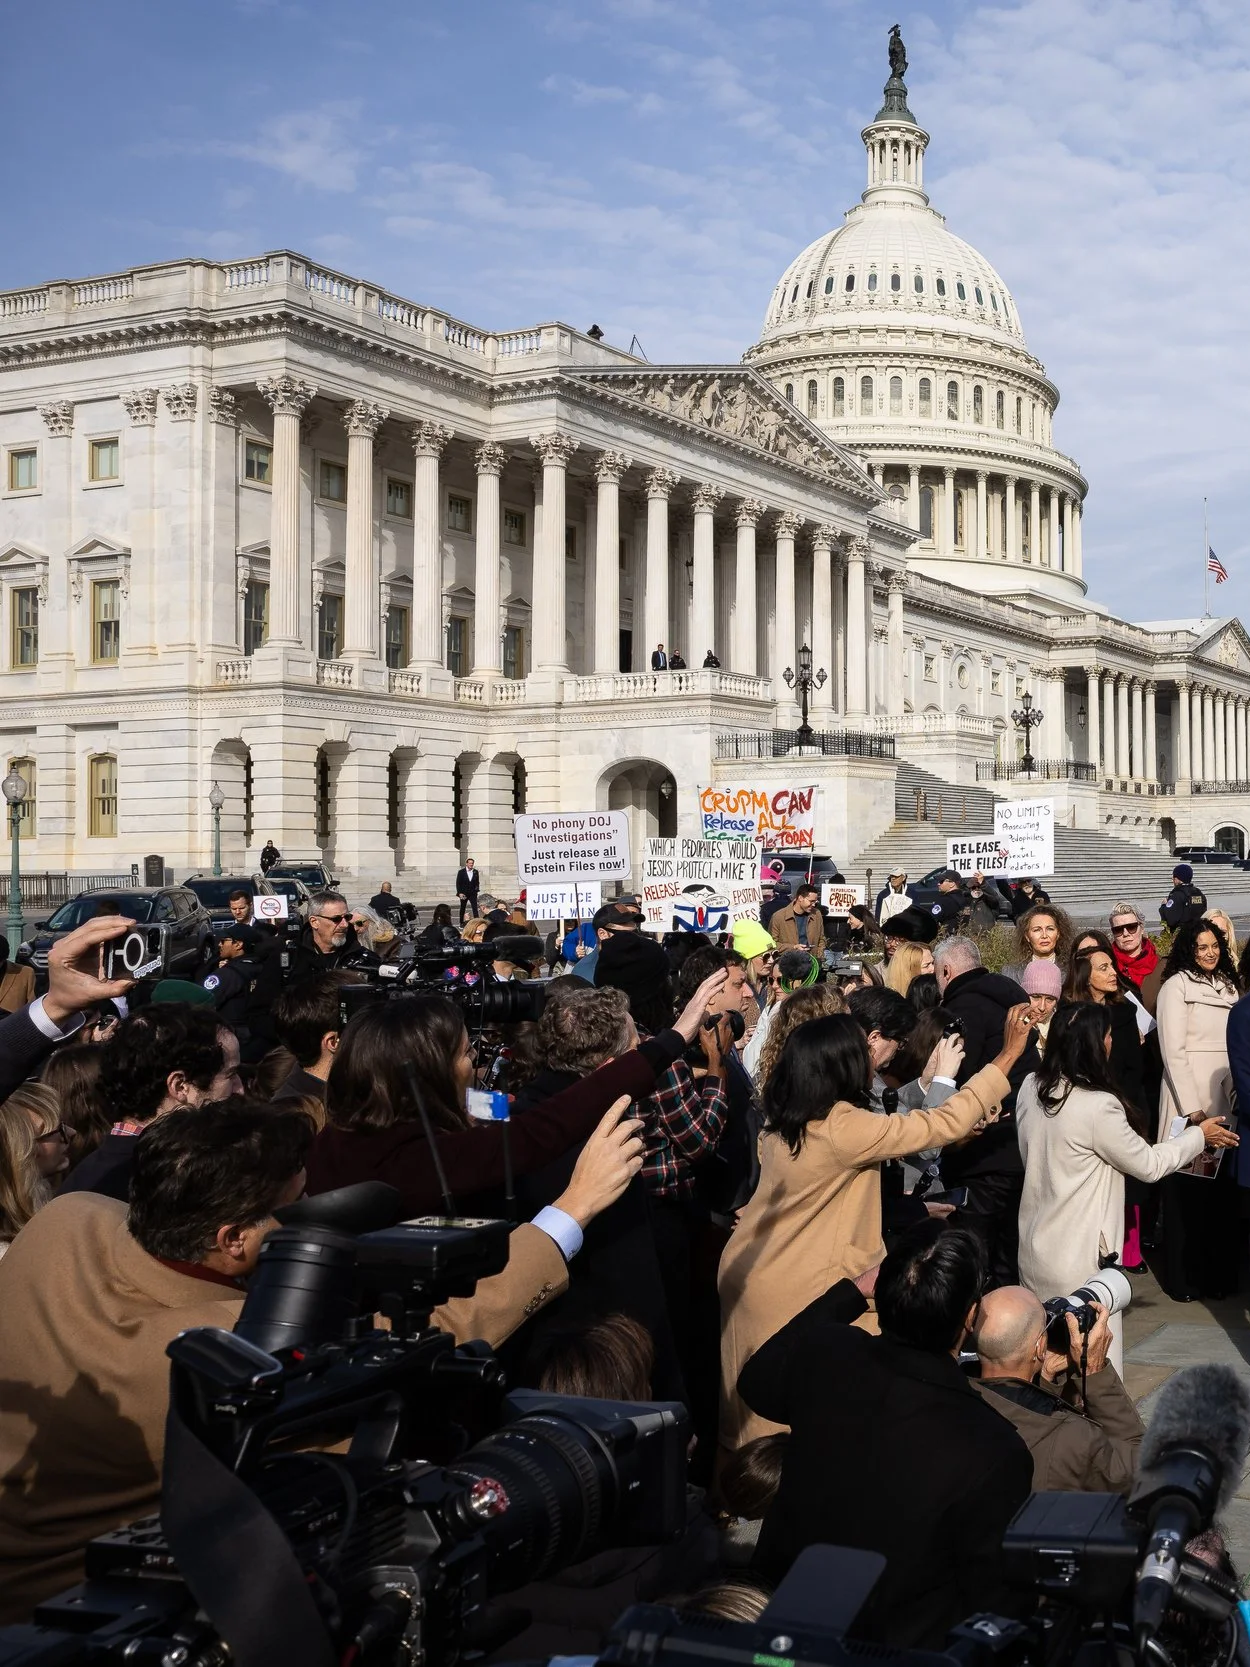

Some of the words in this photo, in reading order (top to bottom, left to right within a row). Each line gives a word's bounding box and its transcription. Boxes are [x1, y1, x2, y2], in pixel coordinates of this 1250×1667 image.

[772, 788, 814, 818] CAN
[997, 808, 1012, 819] NO
[1017, 805, 1051, 818] LIMITS
[532, 819, 548, 830] No
[551, 818, 586, 831] phony
[588, 816, 612, 826] DOJ
[704, 812, 754, 832] Release
[757, 812, 796, 834] ALL
[1002, 821, 1040, 832] Prosecuting
[775, 827, 814, 848] TODAY
[532, 850, 556, 860] Just
[558, 848, 600, 859] release
[603, 846, 616, 856] all
[649, 838, 676, 856] WHICH
[682, 839, 723, 859] PEDOPHILES
[728, 840, 758, 860] WOULD
[952, 841, 1001, 855] RELEASE
[524, 862, 566, 875] Epstein
[570, 862, 596, 872] Files
[599, 859, 626, 869] now!
[646, 860, 674, 877] JESUS
[720, 863, 745, 880] MIKE
[950, 859, 972, 870] THE
[976, 857, 1008, 870] FILES!
[533, 892, 592, 904] JUSTICE
[644, 881, 681, 902] RELEASE
[732, 886, 764, 906] EPSTEIN
[530, 907, 564, 919] WILL
[570, 907, 596, 918] WIN
[648, 906, 664, 922] THE
